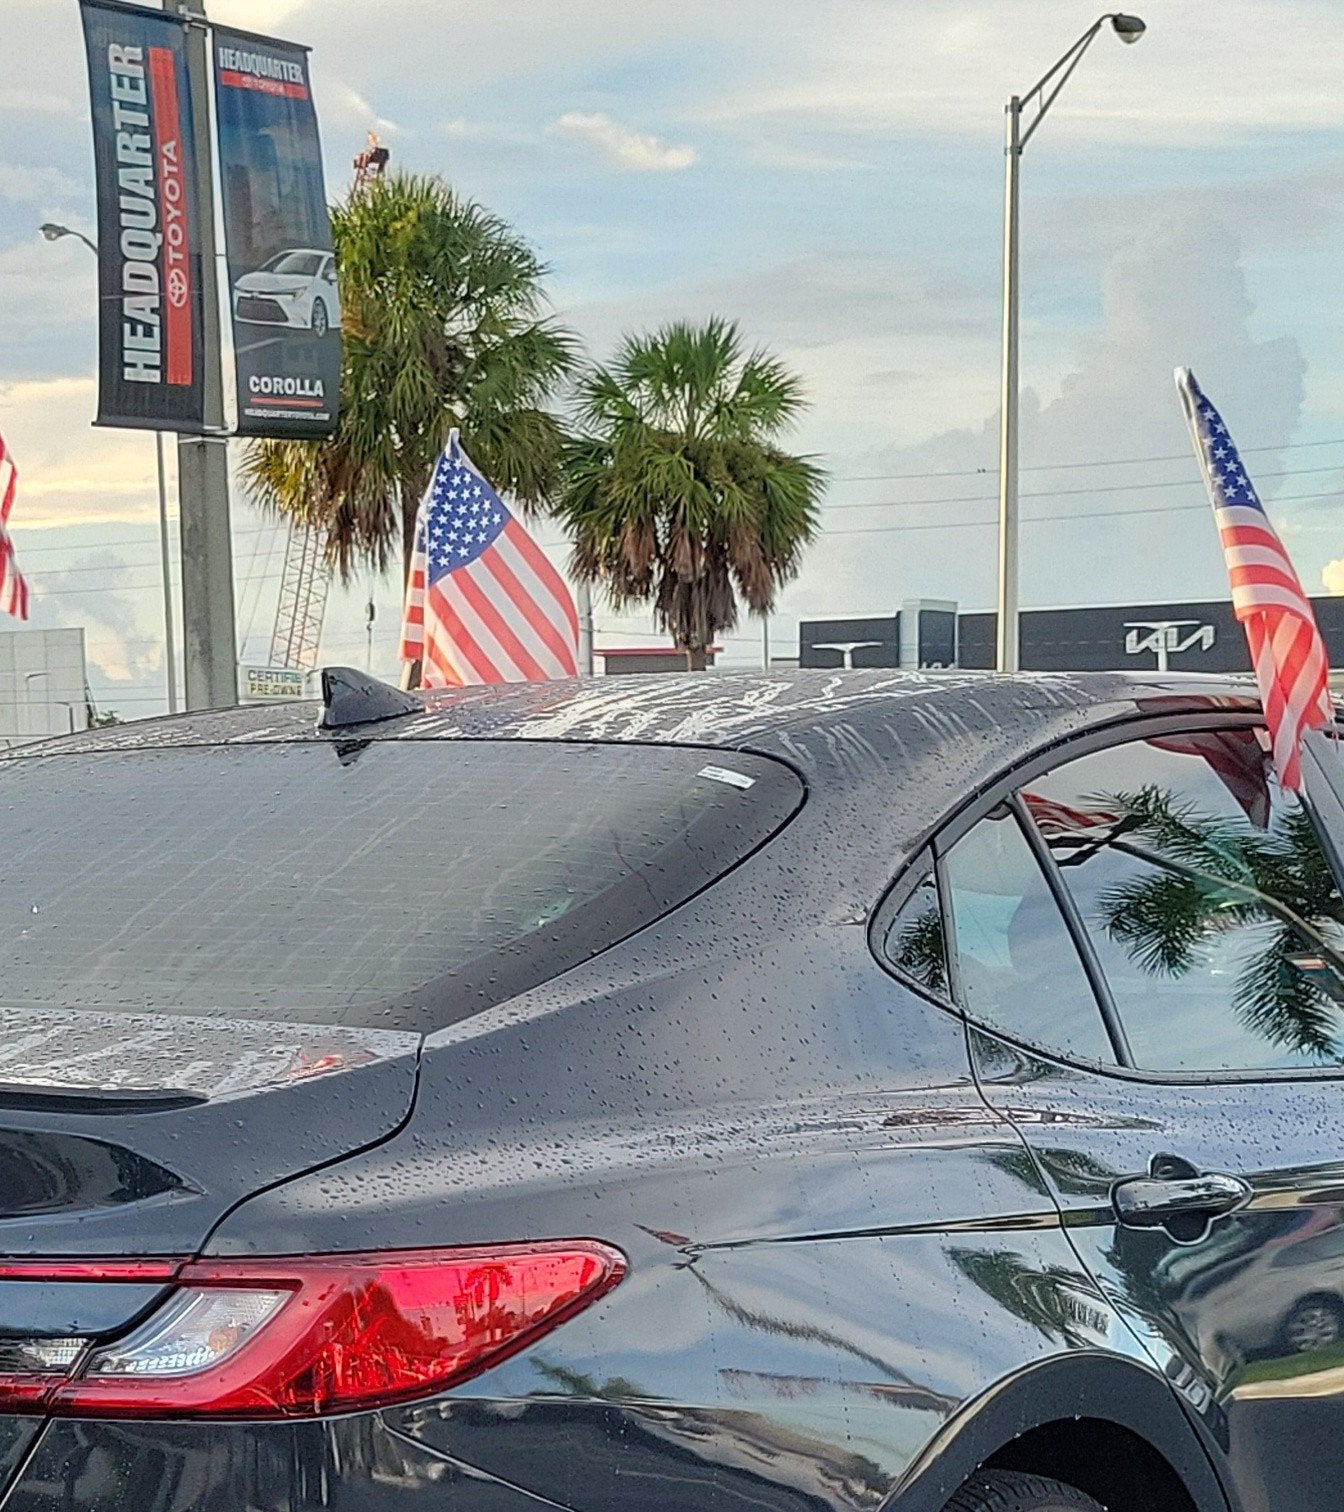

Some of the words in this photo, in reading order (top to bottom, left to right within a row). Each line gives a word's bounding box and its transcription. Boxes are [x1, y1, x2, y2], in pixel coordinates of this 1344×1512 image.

[219, 47, 304, 84] HEADQUARTER
[109, 43, 161, 383] HEADQUARTER
[163, 140, 184, 264] TOYOTA
[249, 375, 324, 398] COROLLA
[248, 670, 302, 683] CERTIFIE
